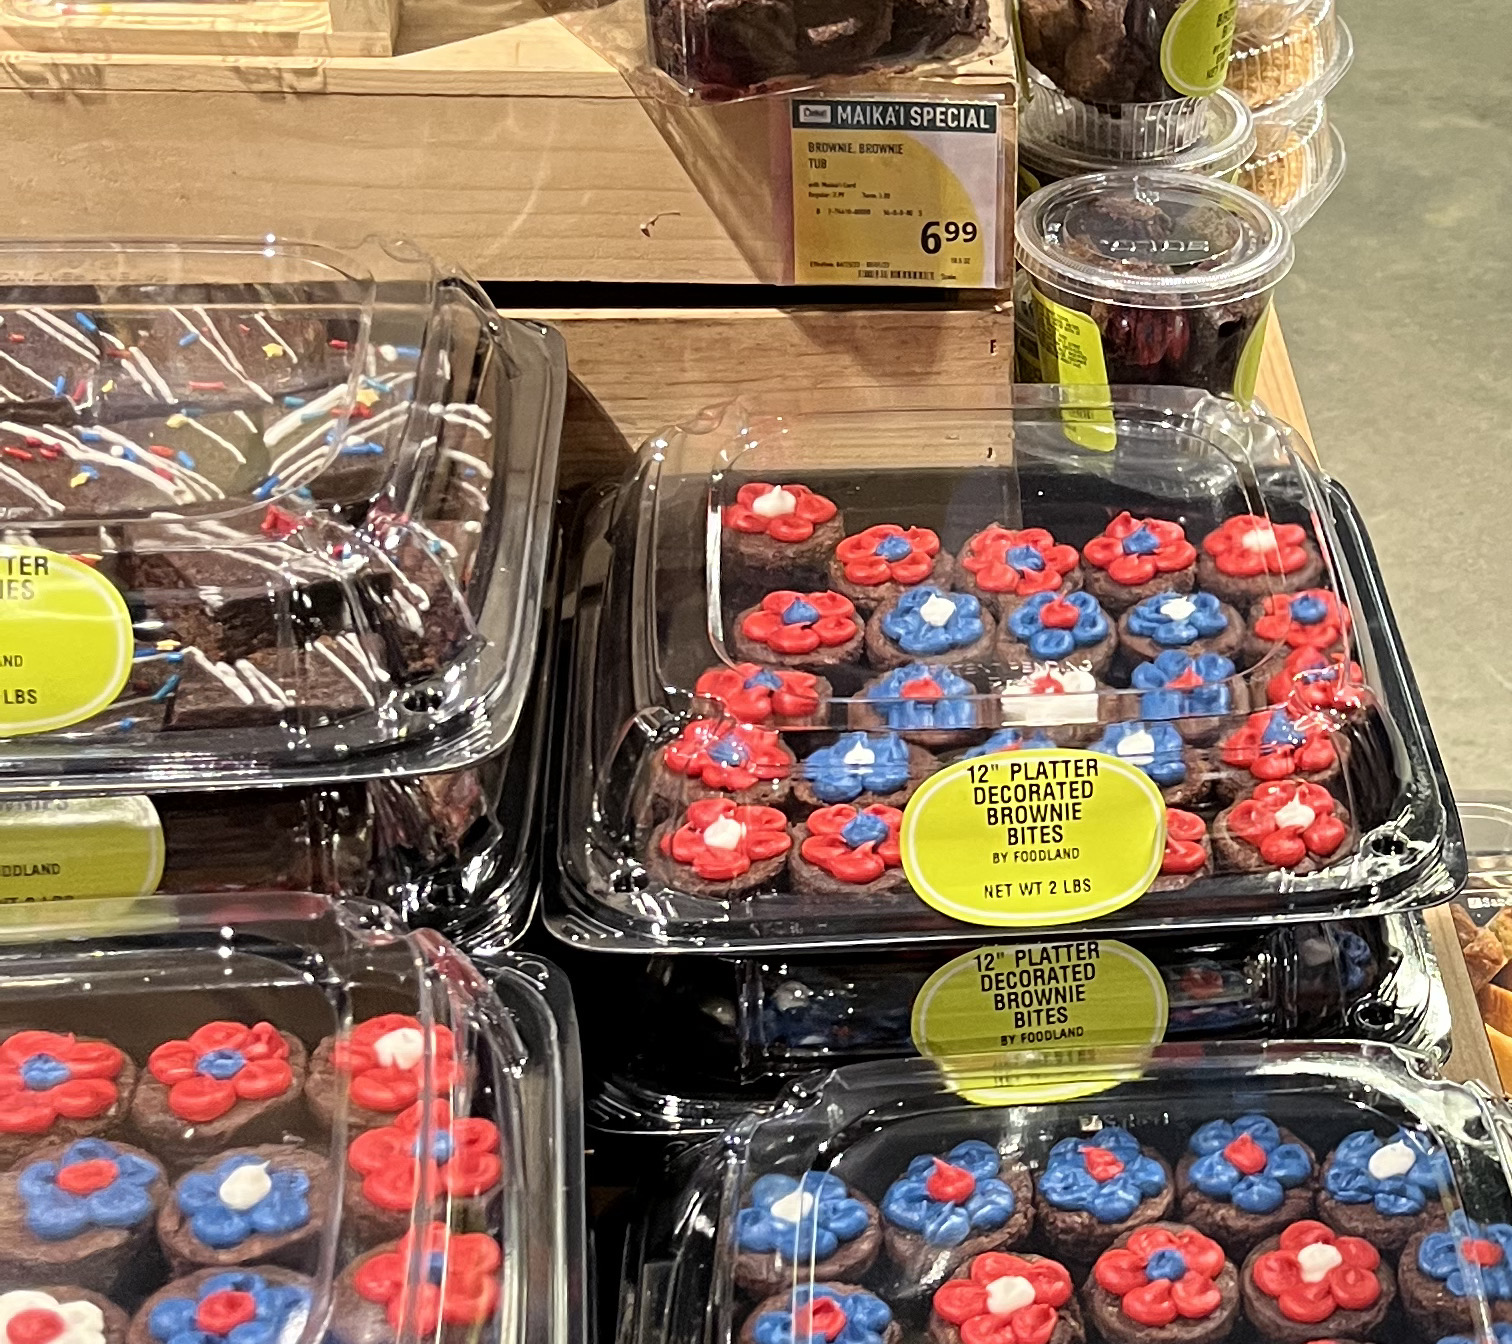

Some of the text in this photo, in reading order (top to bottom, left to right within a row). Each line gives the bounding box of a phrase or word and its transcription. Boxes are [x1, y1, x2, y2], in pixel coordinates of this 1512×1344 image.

[910, 106, 990, 129] SPECIAL
[859, 143, 904, 155] BROWNIE
[808, 158, 827, 169] TUB
[4, 689, 37, 705] LBS
[966, 758, 1099, 784] 12" PLATTER
[973, 780, 1094, 805] DECORATED
[986, 802, 1082, 826] BROWNIE
[1007, 825, 1064, 846] BITES
[992, 848, 1080, 864] BY FOODLAND
[984, 878, 1092, 899] NET WT 2 LBS
[974, 941, 1100, 973] 12" PLATTER
[980, 962, 1096, 992] DECORATED
[994, 984, 1086, 1011] BROWNIE
[1014, 1006, 1068, 1029] BITES
[1000, 1026, 1084, 1046] BY FOODLAND
